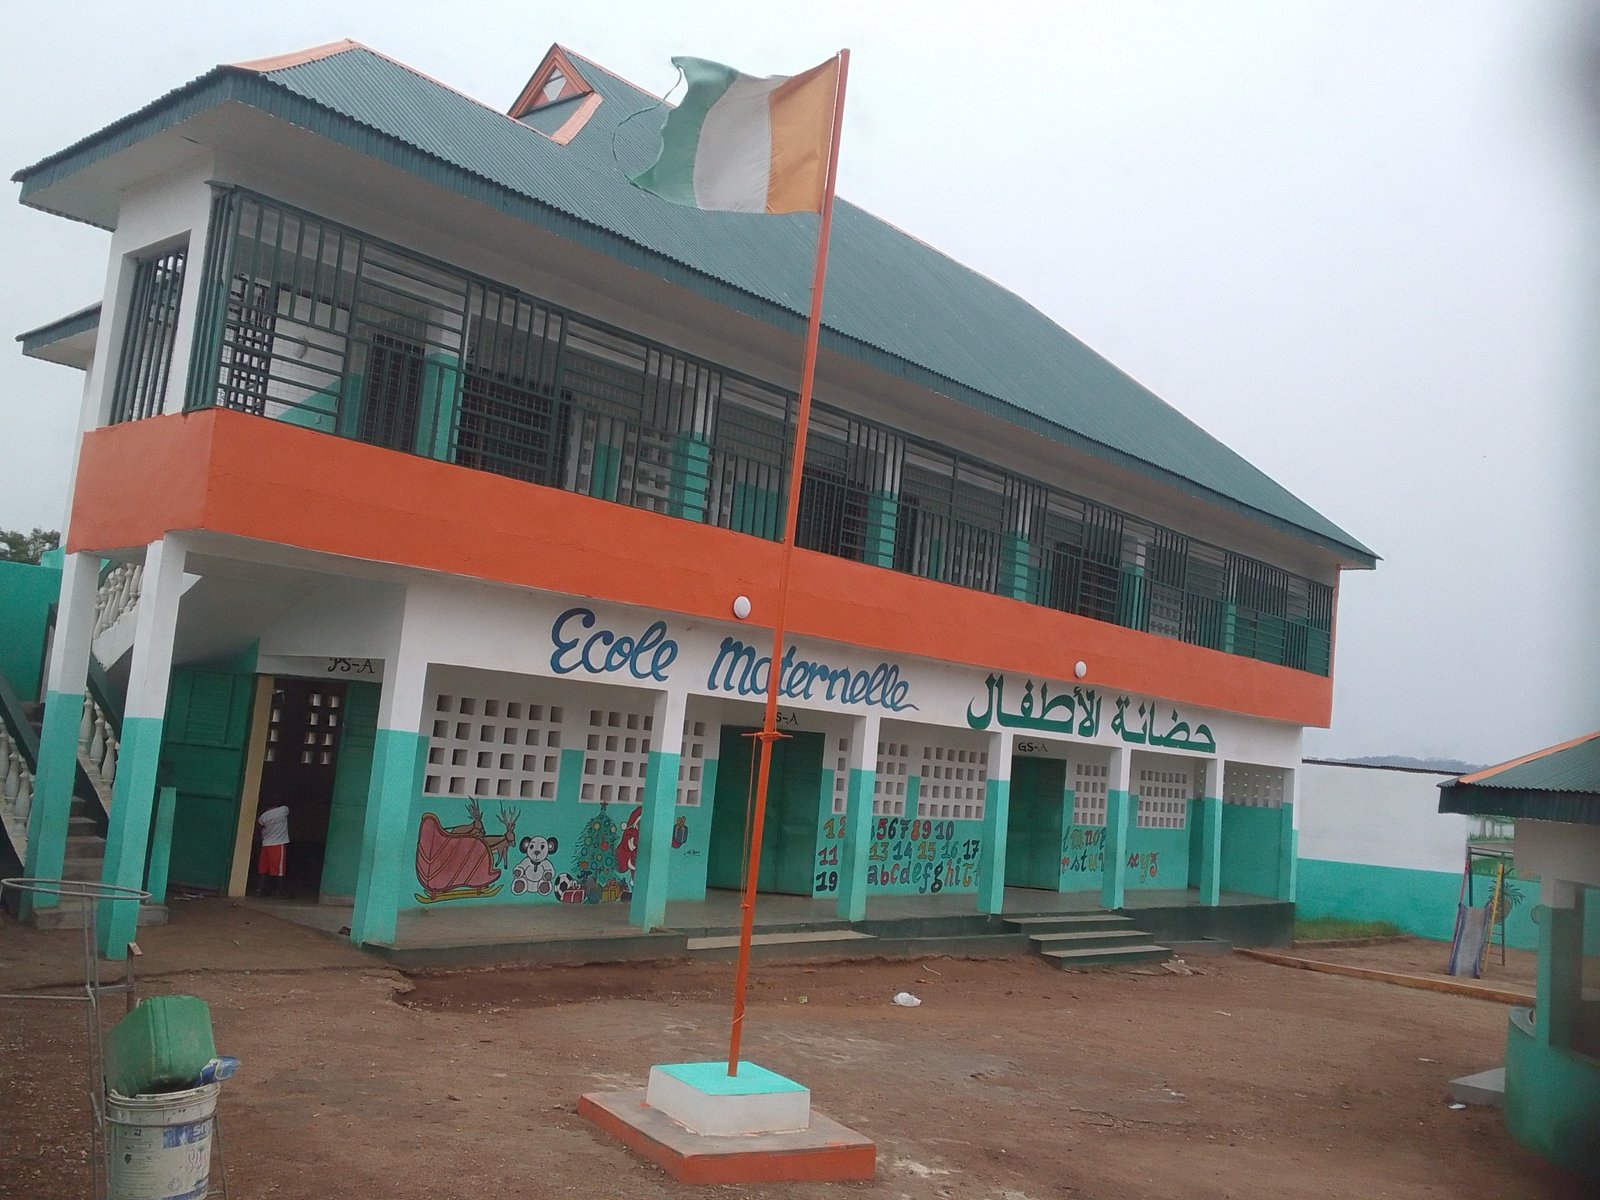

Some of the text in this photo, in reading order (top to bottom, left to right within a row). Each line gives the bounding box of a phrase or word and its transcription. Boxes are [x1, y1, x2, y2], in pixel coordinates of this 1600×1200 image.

[550, 607, 679, 682] Ecole
[762, 711, 799, 726] S-A
[966, 672, 1217, 754] حضانة الأطفال
[817, 843, 839, 866] 11
[868, 841, 890, 862] 13
[892, 840, 913, 860] 14
[917, 840, 937, 862] 15
[962, 838, 981, 861] 17
[815, 870, 839, 893] 19
